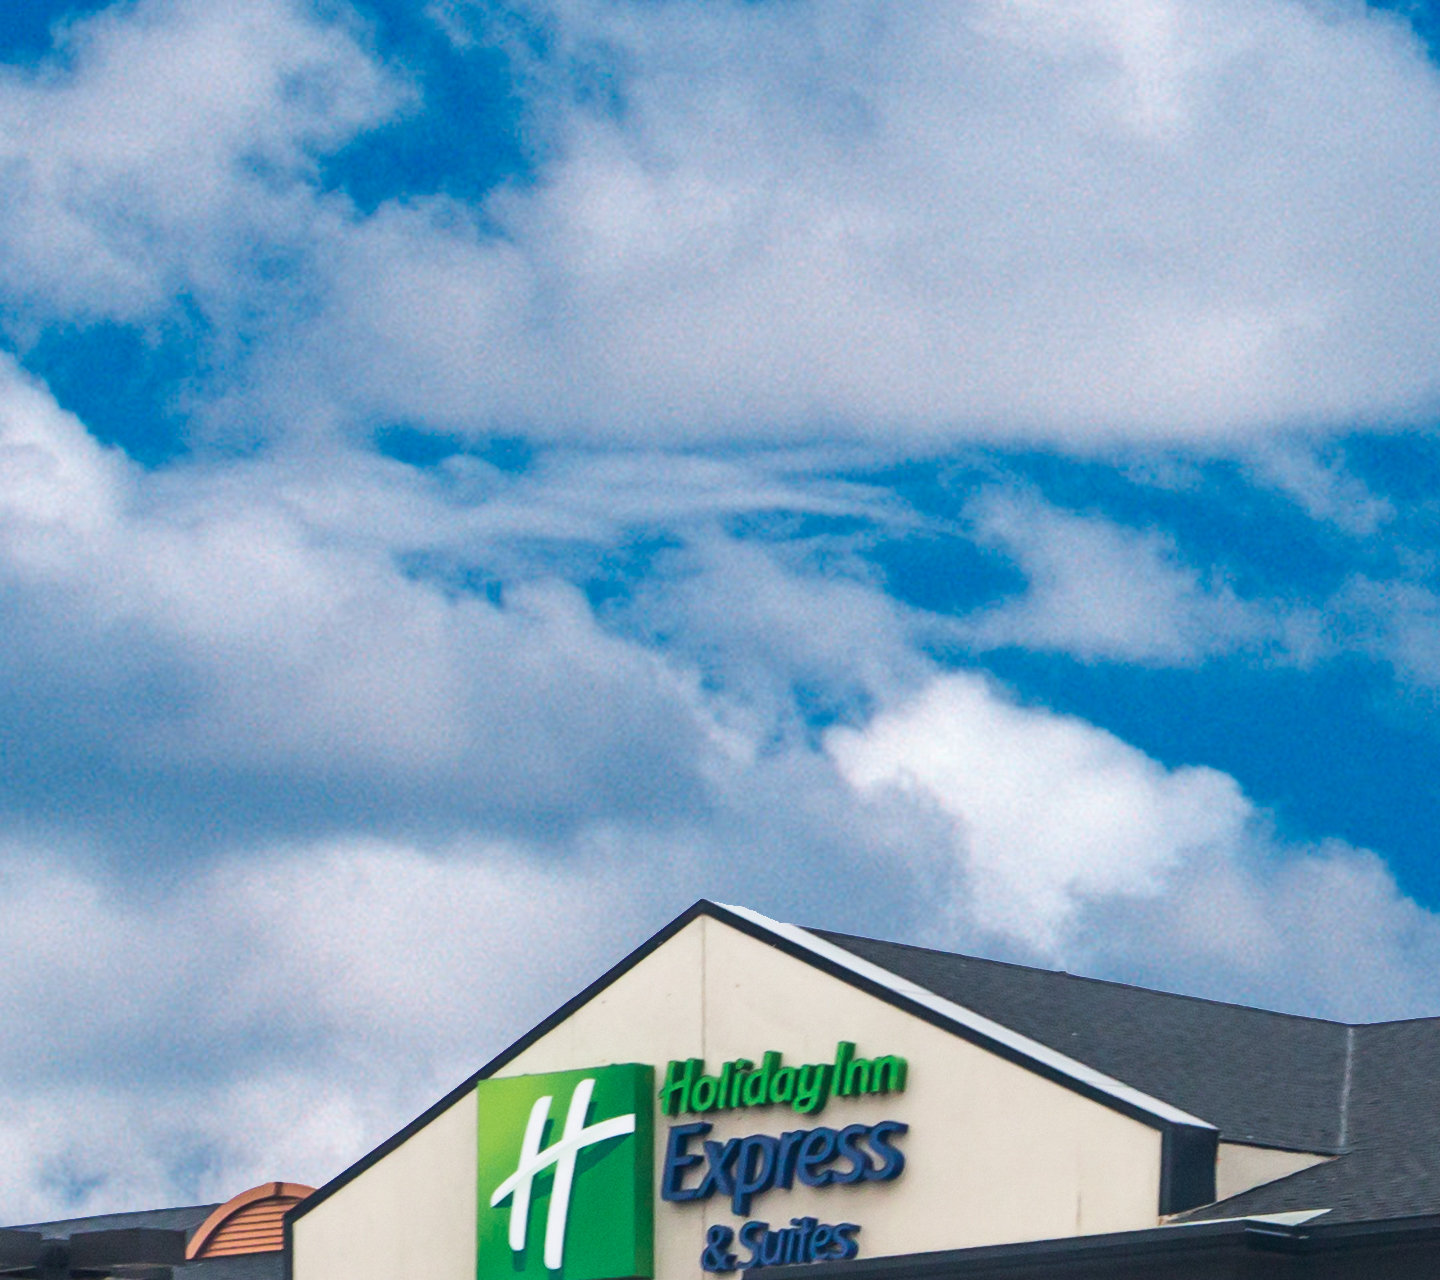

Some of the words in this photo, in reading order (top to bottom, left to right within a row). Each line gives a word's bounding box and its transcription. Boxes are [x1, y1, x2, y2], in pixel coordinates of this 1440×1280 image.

[659, 1050, 832, 1117] Holiday
[831, 1040, 908, 1097] Inn
[661, 1120, 909, 1217] Express
[701, 1224, 737, 1272] &
[736, 1216, 861, 1270] Suites
